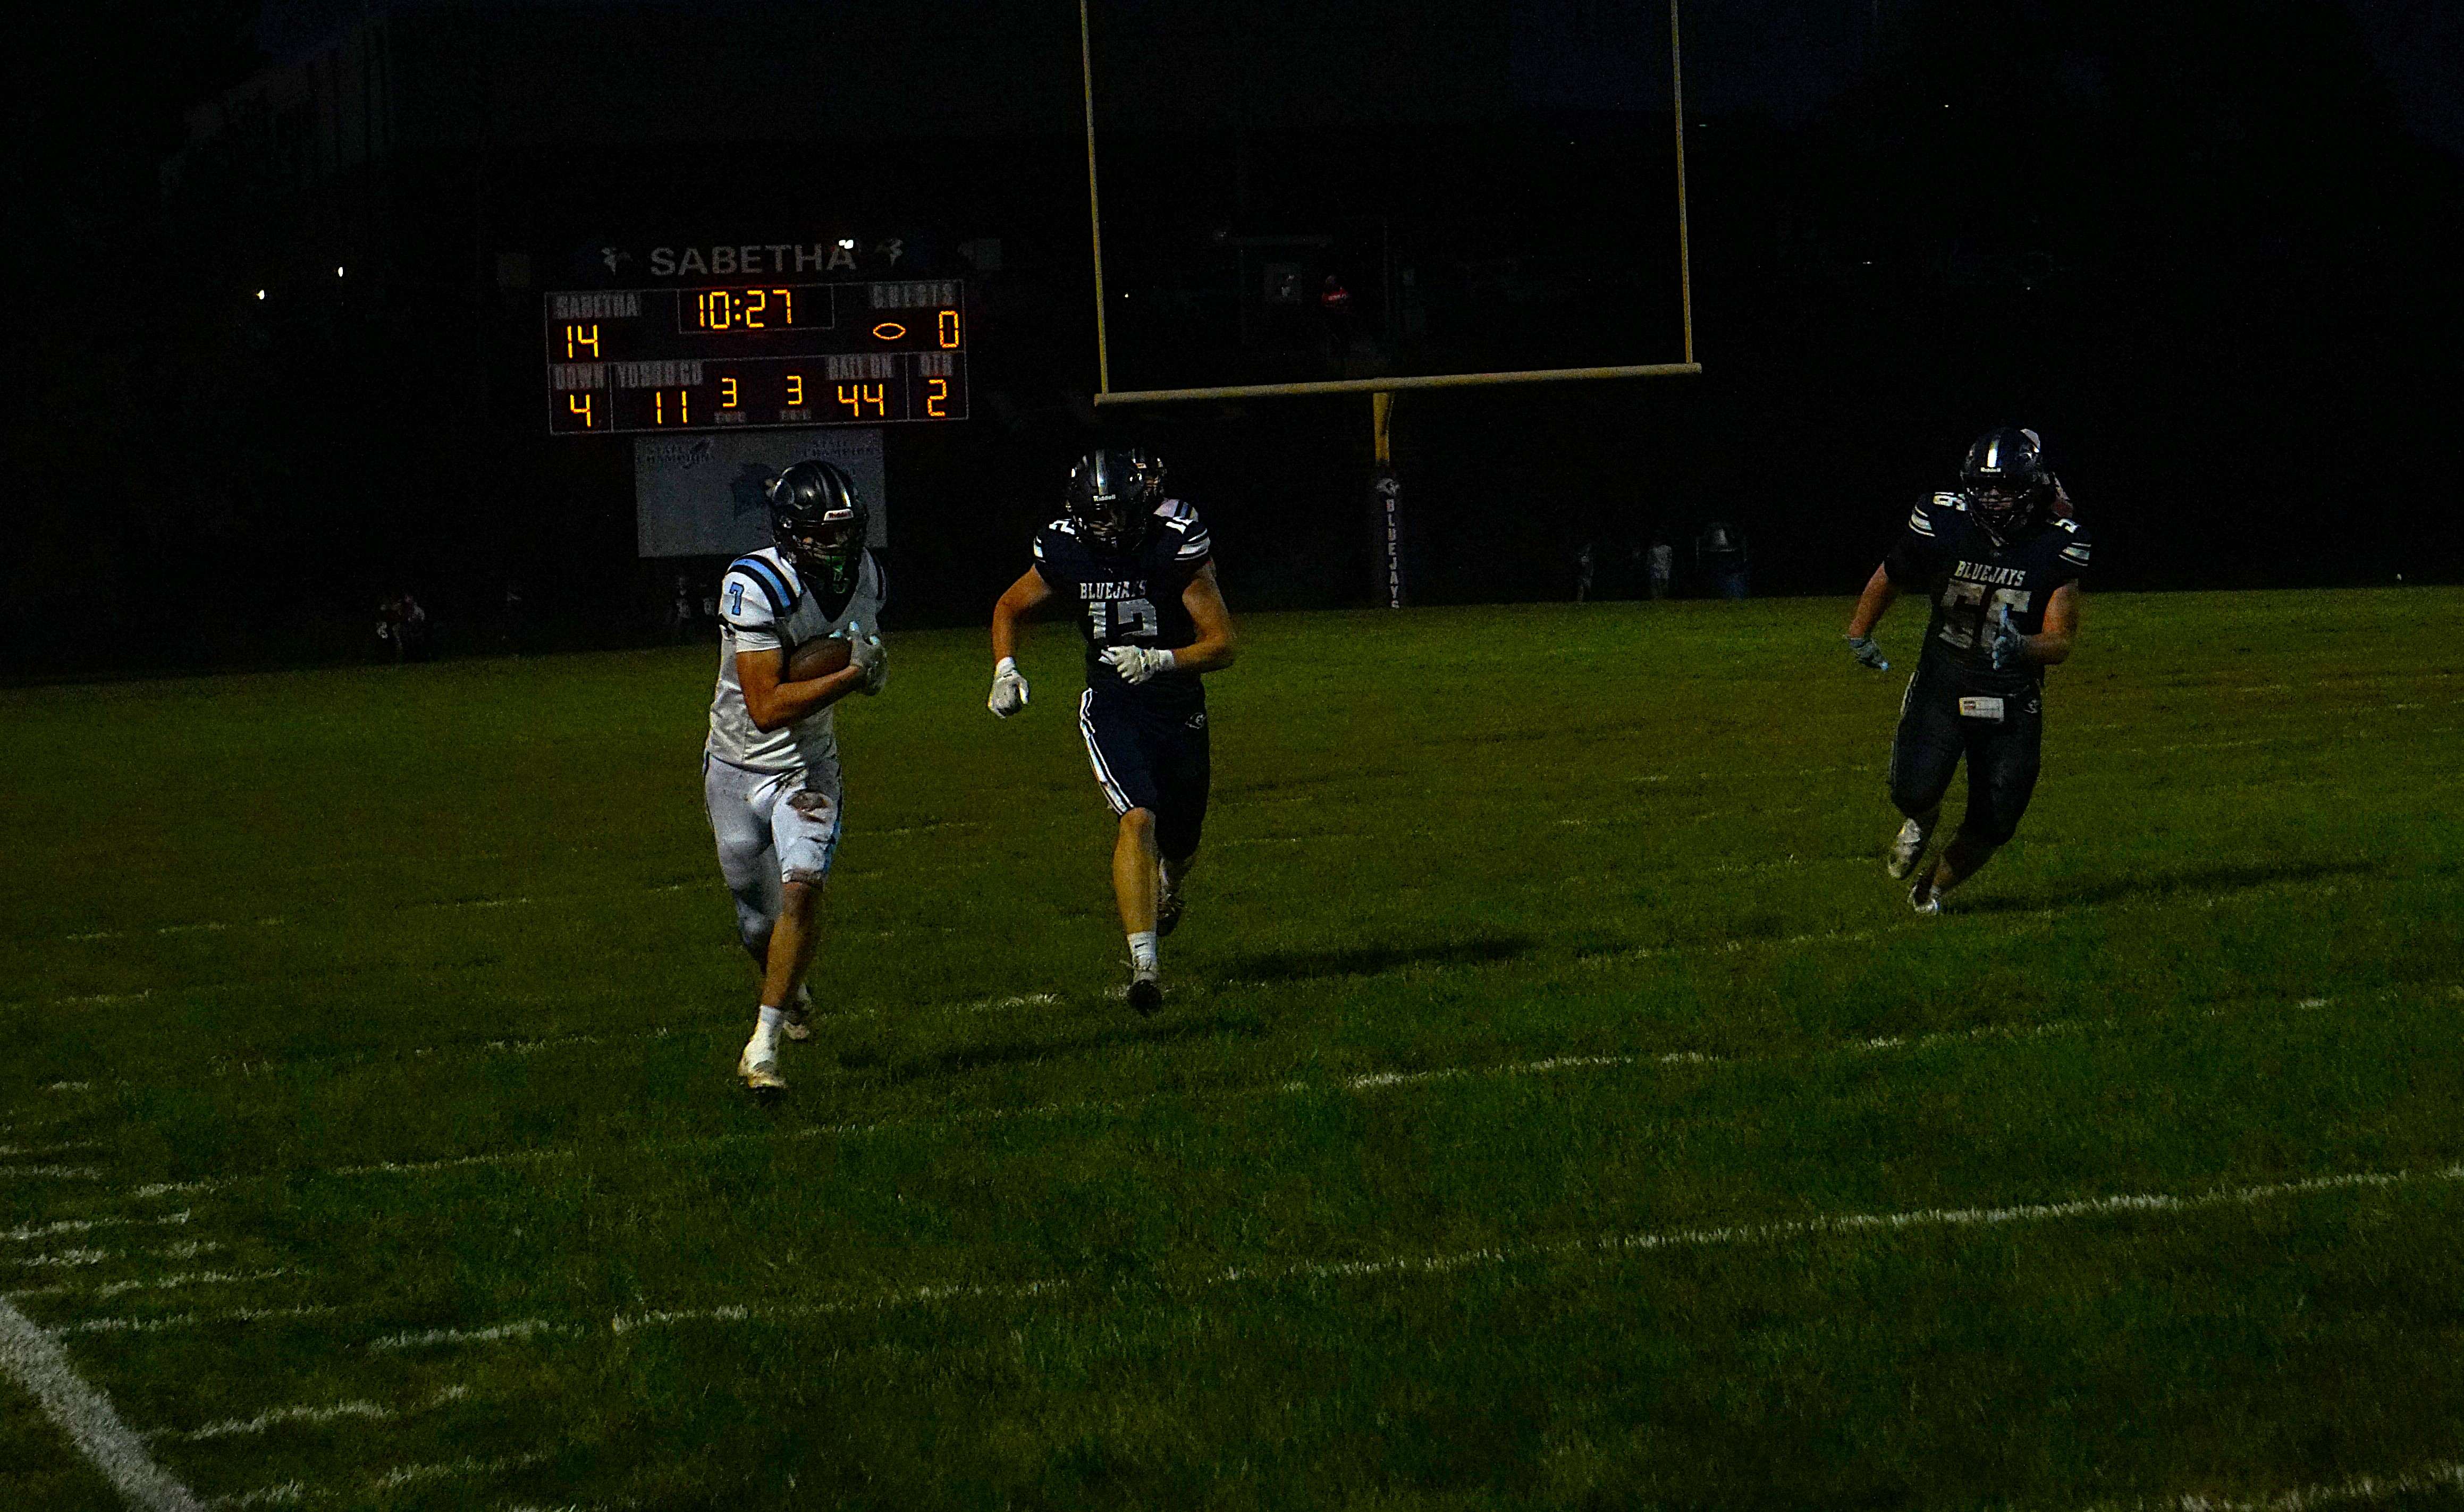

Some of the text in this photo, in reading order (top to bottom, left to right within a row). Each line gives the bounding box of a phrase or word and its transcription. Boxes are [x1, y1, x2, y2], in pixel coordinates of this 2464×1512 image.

[650, 243, 857, 276] SABETHA
[698, 289, 792, 330] 10:27
[566, 324, 598, 359] 14
[938, 310, 959, 349] 0
[655, 390, 688, 425] 11
[722, 377, 738, 408] 3
[787, 375, 803, 406] 3
[838, 383, 884, 417] 44
[926, 378, 948, 417] 2
[570, 394, 592, 428] 4
[1386, 499, 1399, 609] BLUEJAYS
[1079, 579, 1147, 599] BLUEJAS
[1954, 560, 2027, 587] BLUEJAYS
[729, 581, 745, 616] 7
[1088, 598, 1158, 639] 12
